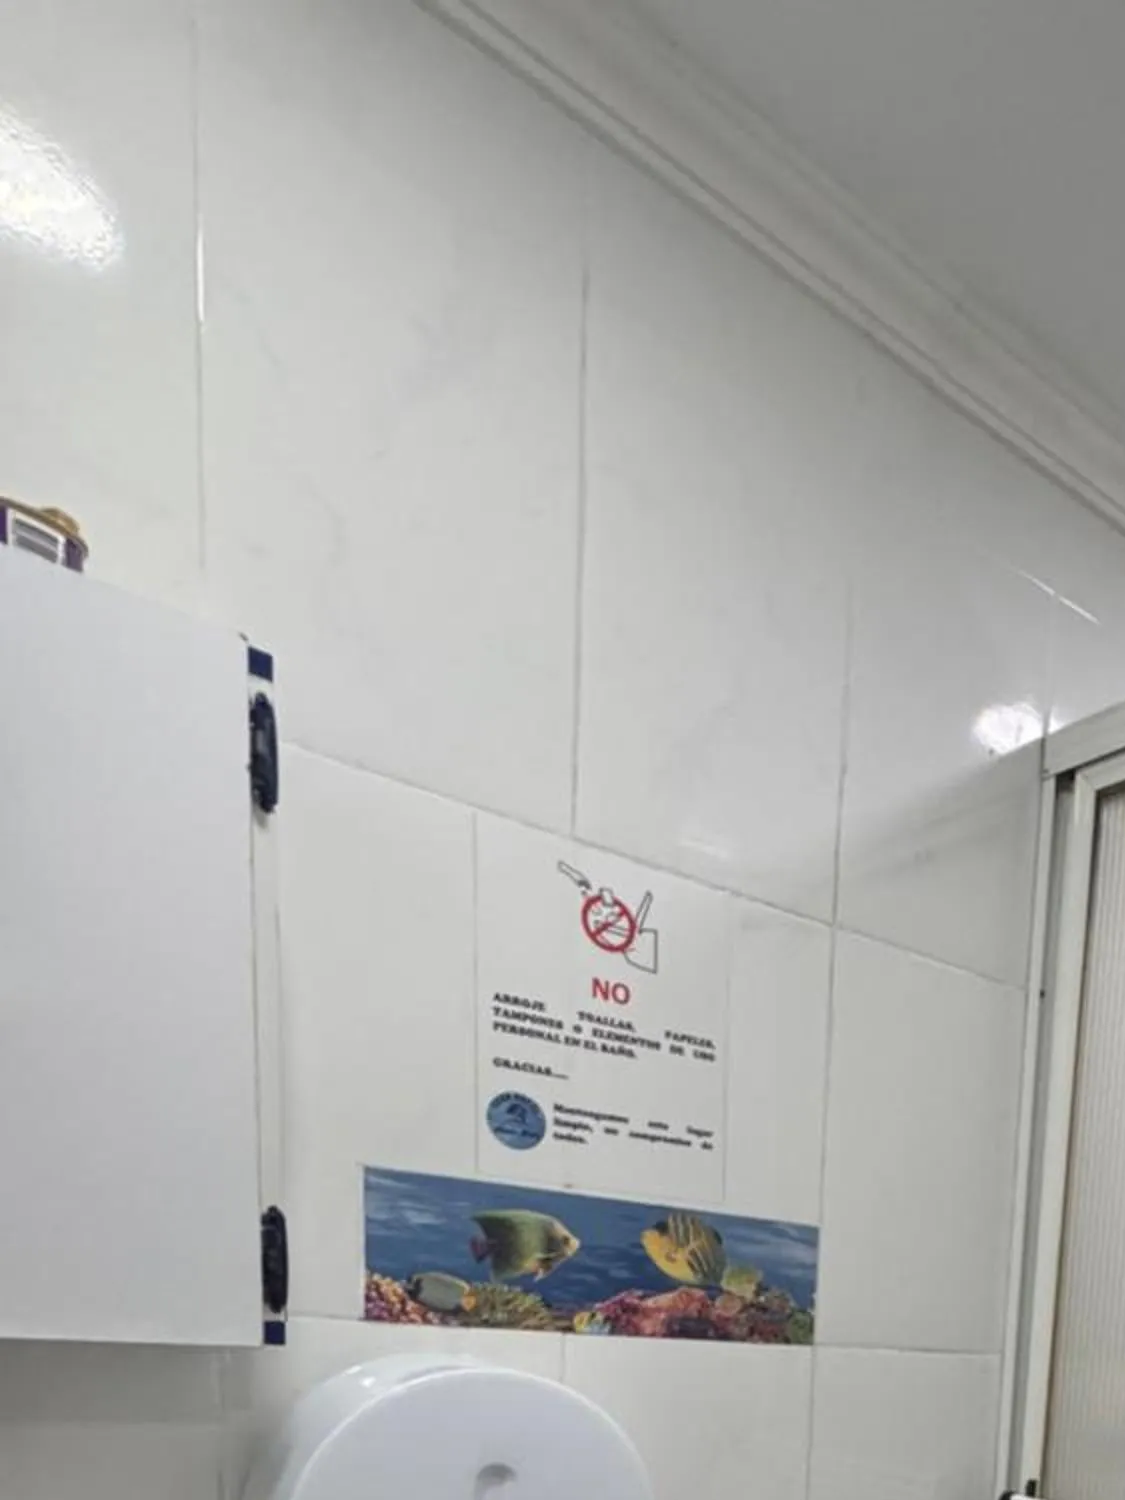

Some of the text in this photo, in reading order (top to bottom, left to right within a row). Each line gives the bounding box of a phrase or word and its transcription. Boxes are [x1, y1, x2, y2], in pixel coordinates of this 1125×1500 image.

[592, 977, 631, 1005] NO
[492, 1006, 563, 1030] TAMPONES
[592, 1027, 661, 1051] ELEMENTOS
[669, 1043, 684, 1056] DE
[493, 1020, 561, 1044] PERSONAL
[564, 1035, 581, 1047] EN
[583, 1039, 598, 1051] EL
